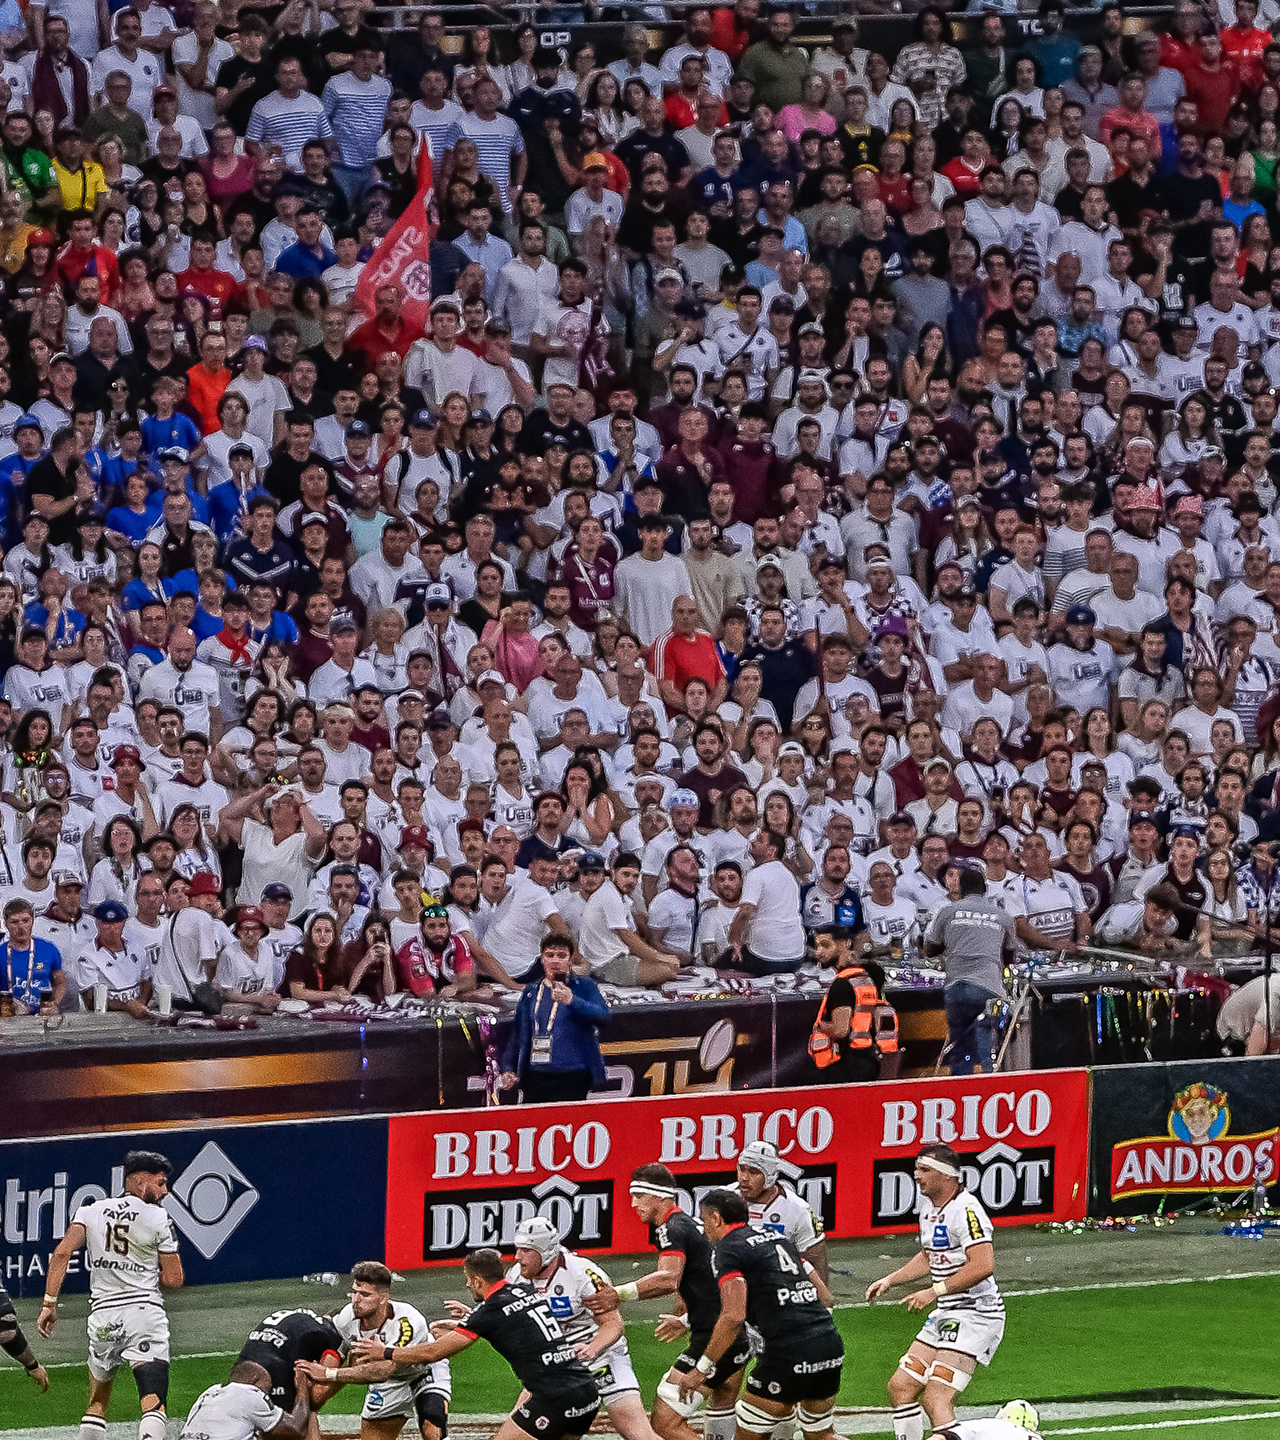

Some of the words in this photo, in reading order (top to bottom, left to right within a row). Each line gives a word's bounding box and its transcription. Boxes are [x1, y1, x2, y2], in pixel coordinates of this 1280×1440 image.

[659, 1106, 834, 1163] BRICO
[881, 1089, 1052, 1148] BRICO
[432, 1121, 611, 1180] BRICO
[1114, 1139, 1274, 1189] ANDROS
[103, 1208, 139, 1222] FAYAT
[105, 1222, 130, 1257] 15
[775, 1244, 800, 1276] 4
[527, 1305, 564, 1342] 15
